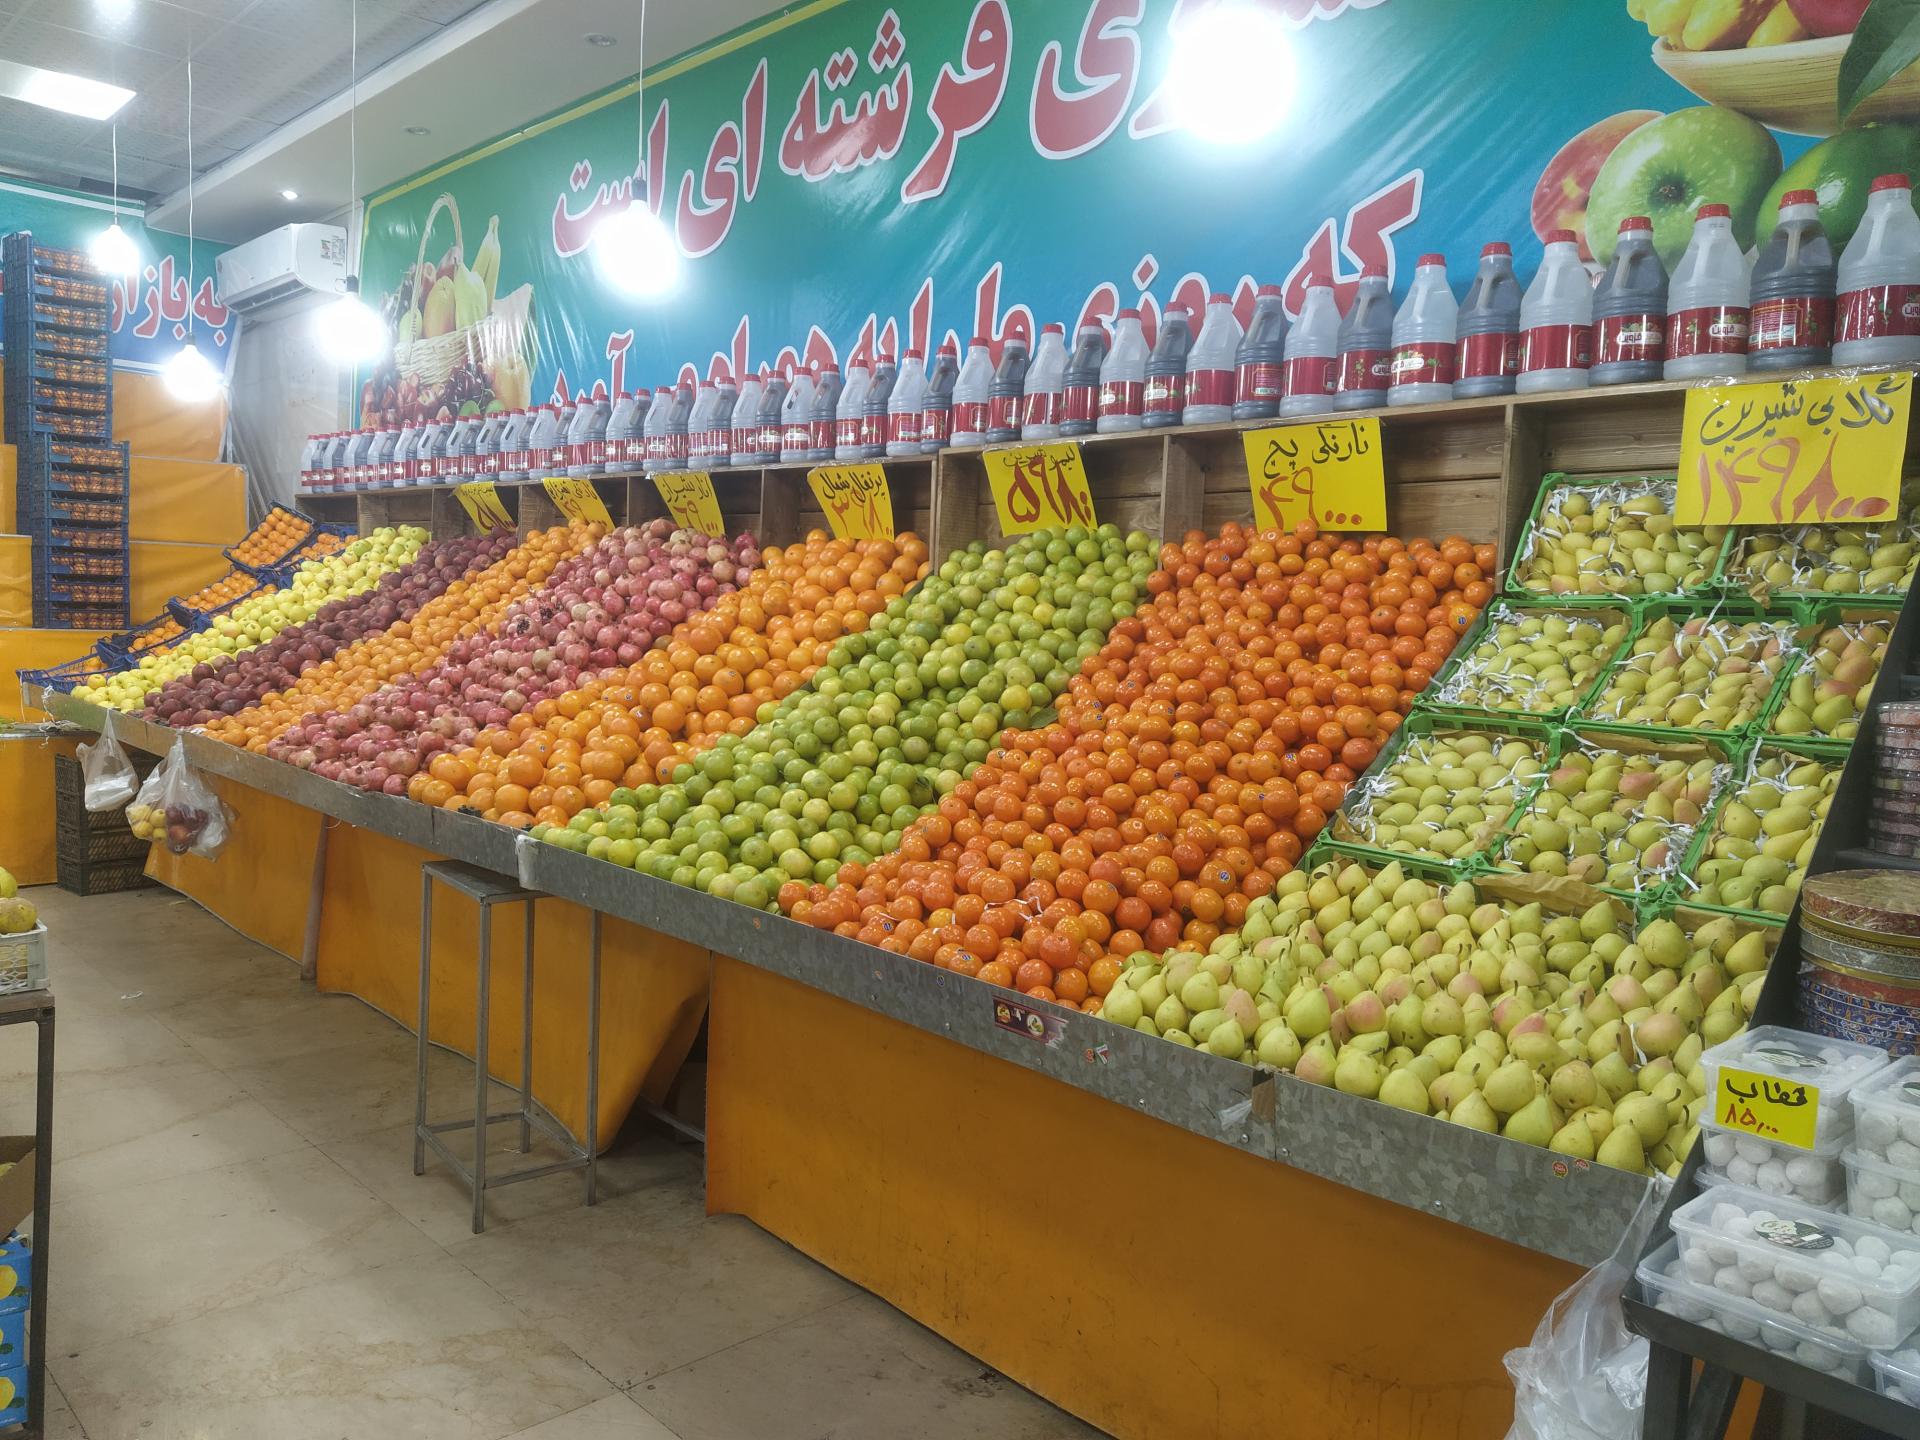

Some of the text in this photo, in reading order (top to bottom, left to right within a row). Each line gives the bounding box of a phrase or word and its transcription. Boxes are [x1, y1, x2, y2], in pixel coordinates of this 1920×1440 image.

[552, 98, 669, 258] است
[675, 57, 768, 258] ای
[1282, 168, 1425, 321] که
[193, 276, 229, 347] به
[1312, 422, 1369, 464] نارنگی
[1700, 377, 1908, 455] گلابی شیرین
[694, 474, 714, 500] انار
[1003, 445, 1076, 471] لیمو شیرین
[1259, 467, 1362, 530] ۴۹۰۰۰
